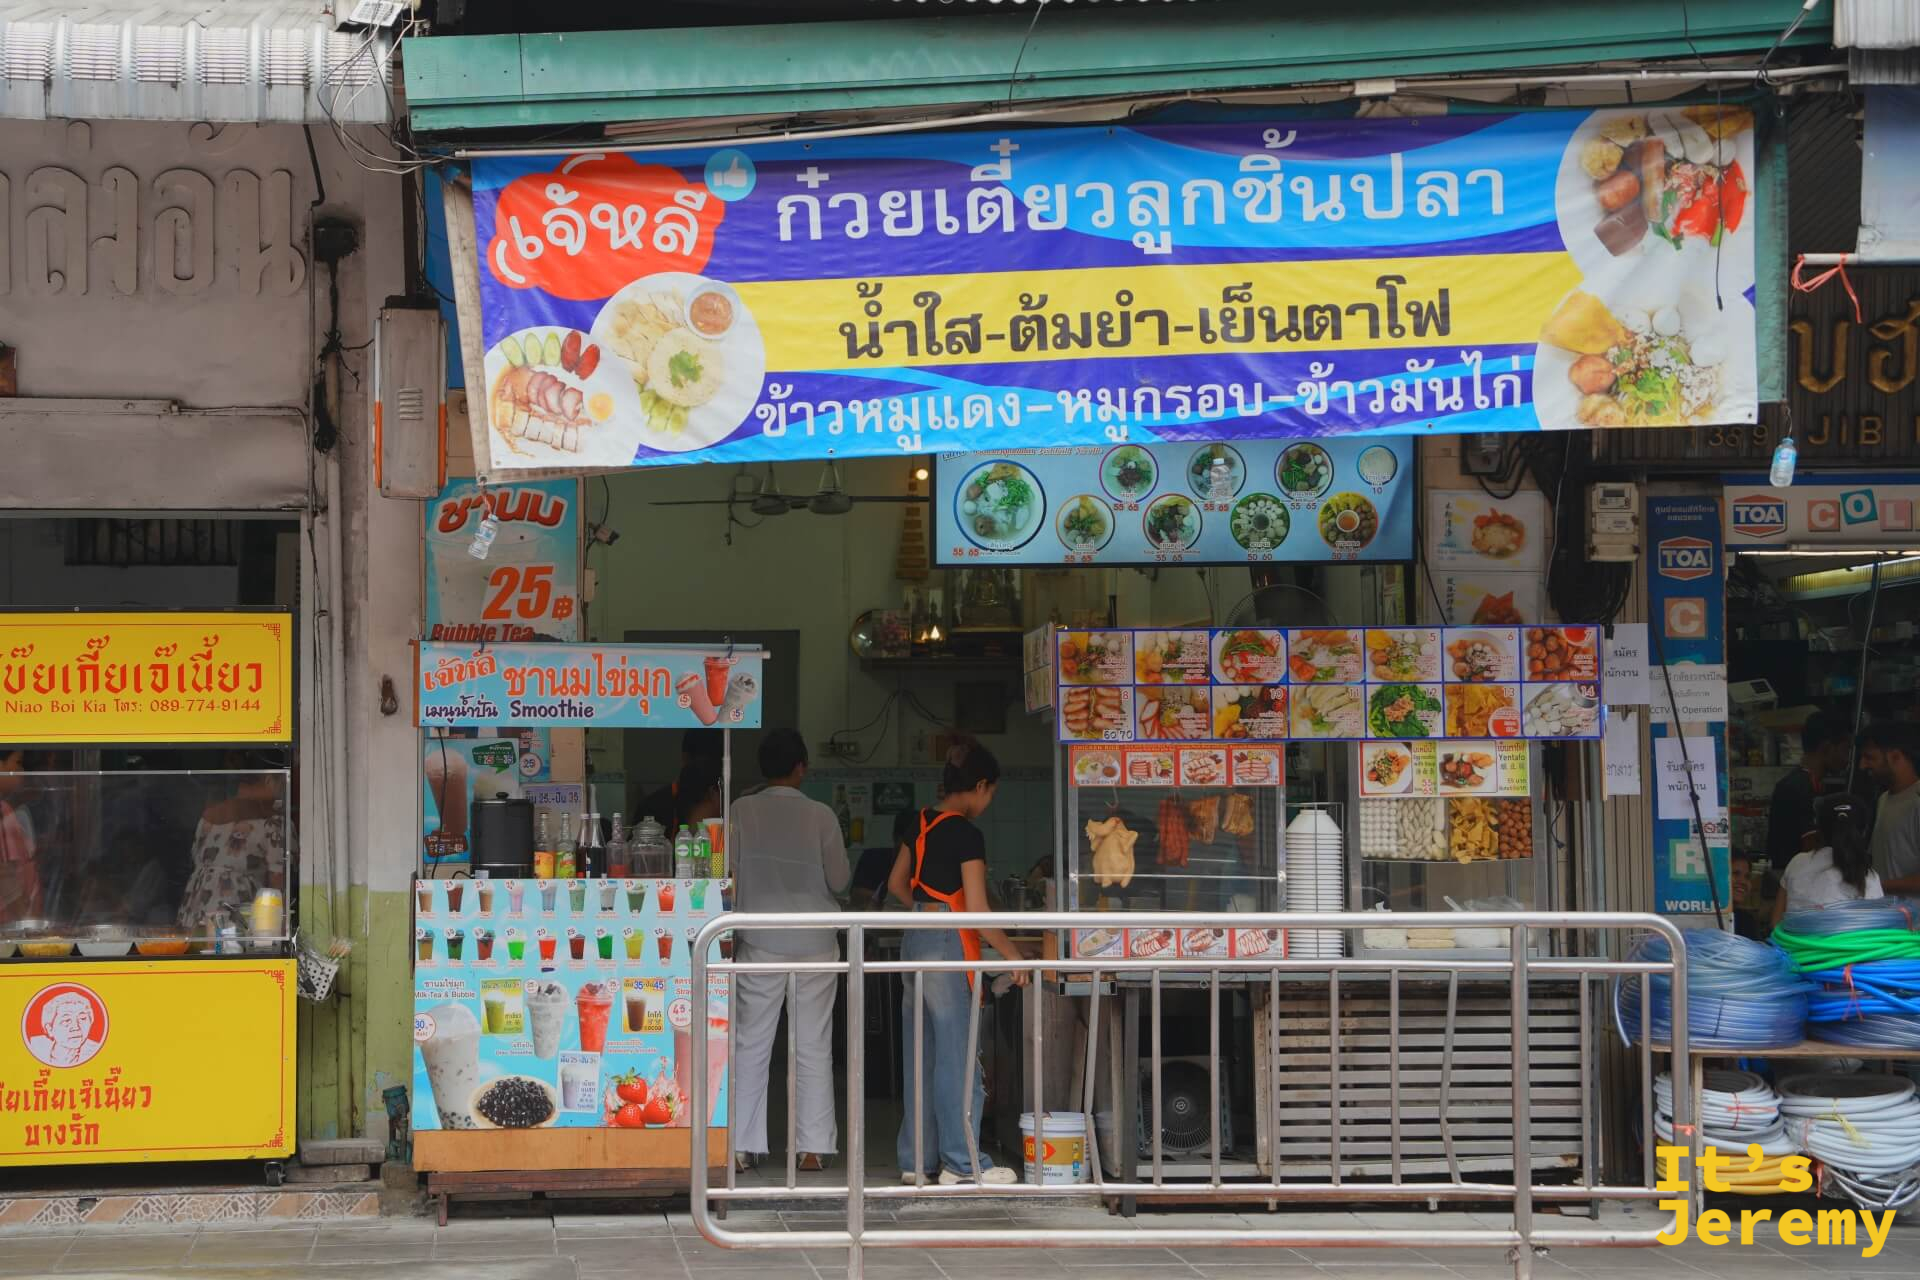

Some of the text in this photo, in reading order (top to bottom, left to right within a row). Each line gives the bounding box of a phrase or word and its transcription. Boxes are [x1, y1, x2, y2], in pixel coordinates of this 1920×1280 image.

[777, 128, 1505, 254] ก๋วยเตี๋ยวลูกชิ้นปลา
[510, 183, 708, 260] เจ้หลี
[840, 275, 1452, 359] น้ำใส-ต้มยำ-เย็นตาโฟ
[1808, 415, 1883, 446] JIB
[438, 490, 566, 533] ชานม
[1735, 506, 1782, 524] TOA
[1662, 549, 1709, 568] TOA
[502, 624, 535, 641] Tea
[503, 654, 671, 715] ชานมไข่มุก
[5, 699, 43, 713] Niao
[50, 699, 76, 713] Boi
[83, 699, 107, 713] Kia
[150, 699, 261, 713] 089-774-9144
[510, 699, 595, 719] Smoothie
[1681, 705, 1724, 718] Operation
[1104, 730, 1133, 740] 60 70
[25, 1113, 100, 1146] บางรัก
